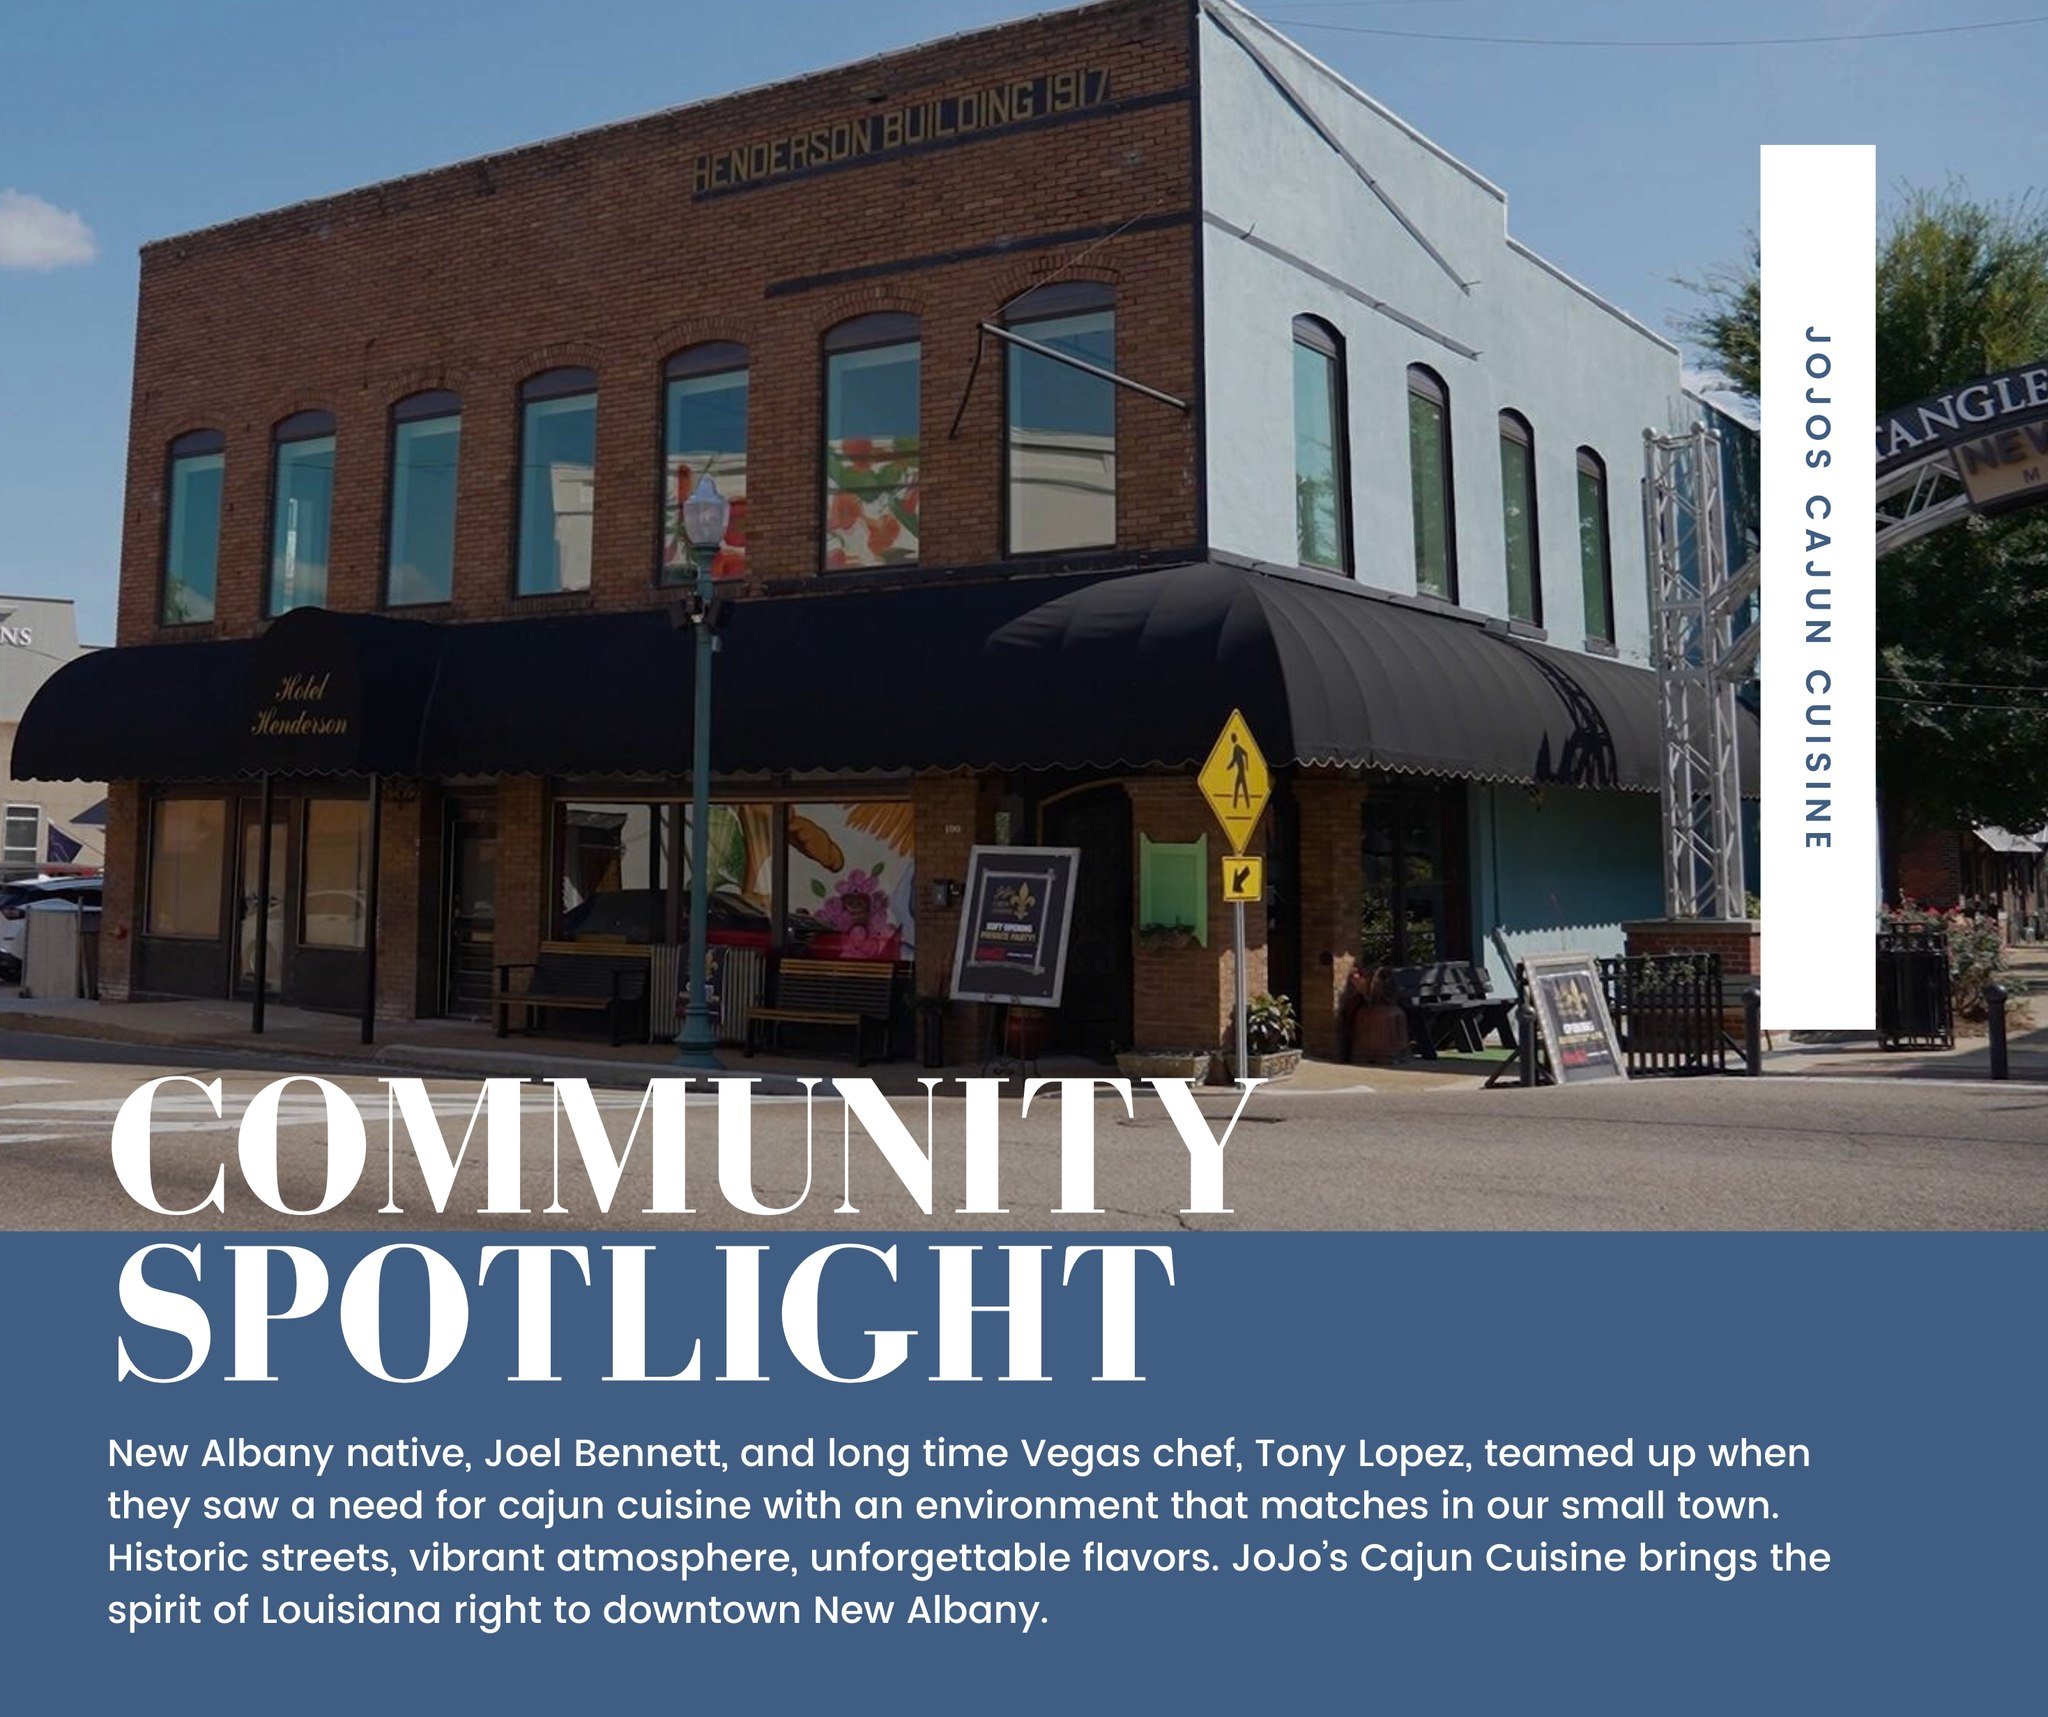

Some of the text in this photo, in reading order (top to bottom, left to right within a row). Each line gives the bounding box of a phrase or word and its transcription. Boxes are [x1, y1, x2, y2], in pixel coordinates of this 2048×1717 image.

[692, 64, 1111, 193] HENDERSON BUILDING 1917
[275, 672, 331, 701] Hotel
[250, 706, 348, 736] Henderson
